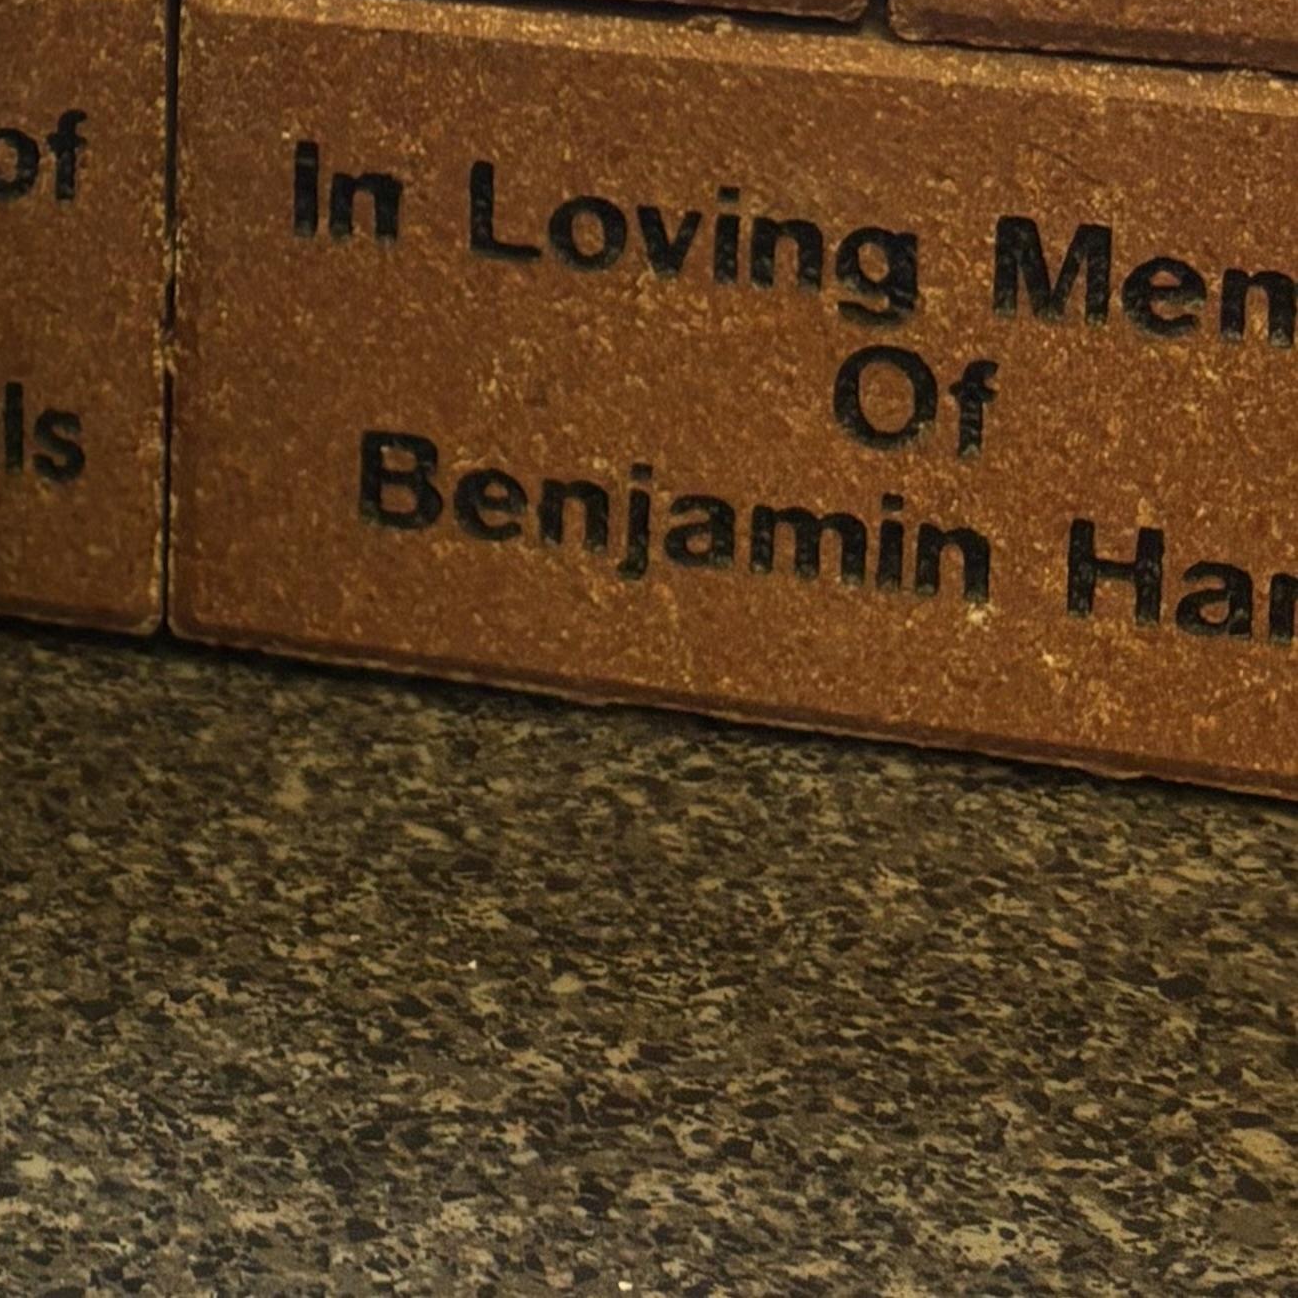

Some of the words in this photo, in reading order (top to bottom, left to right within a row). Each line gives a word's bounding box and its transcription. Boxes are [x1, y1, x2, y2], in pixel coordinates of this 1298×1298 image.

[294, 141, 403, 241] In
[469, 161, 919, 327] Loving
[834, 345, 998, 459] Of
[357, 423, 991, 603] Benjamin
